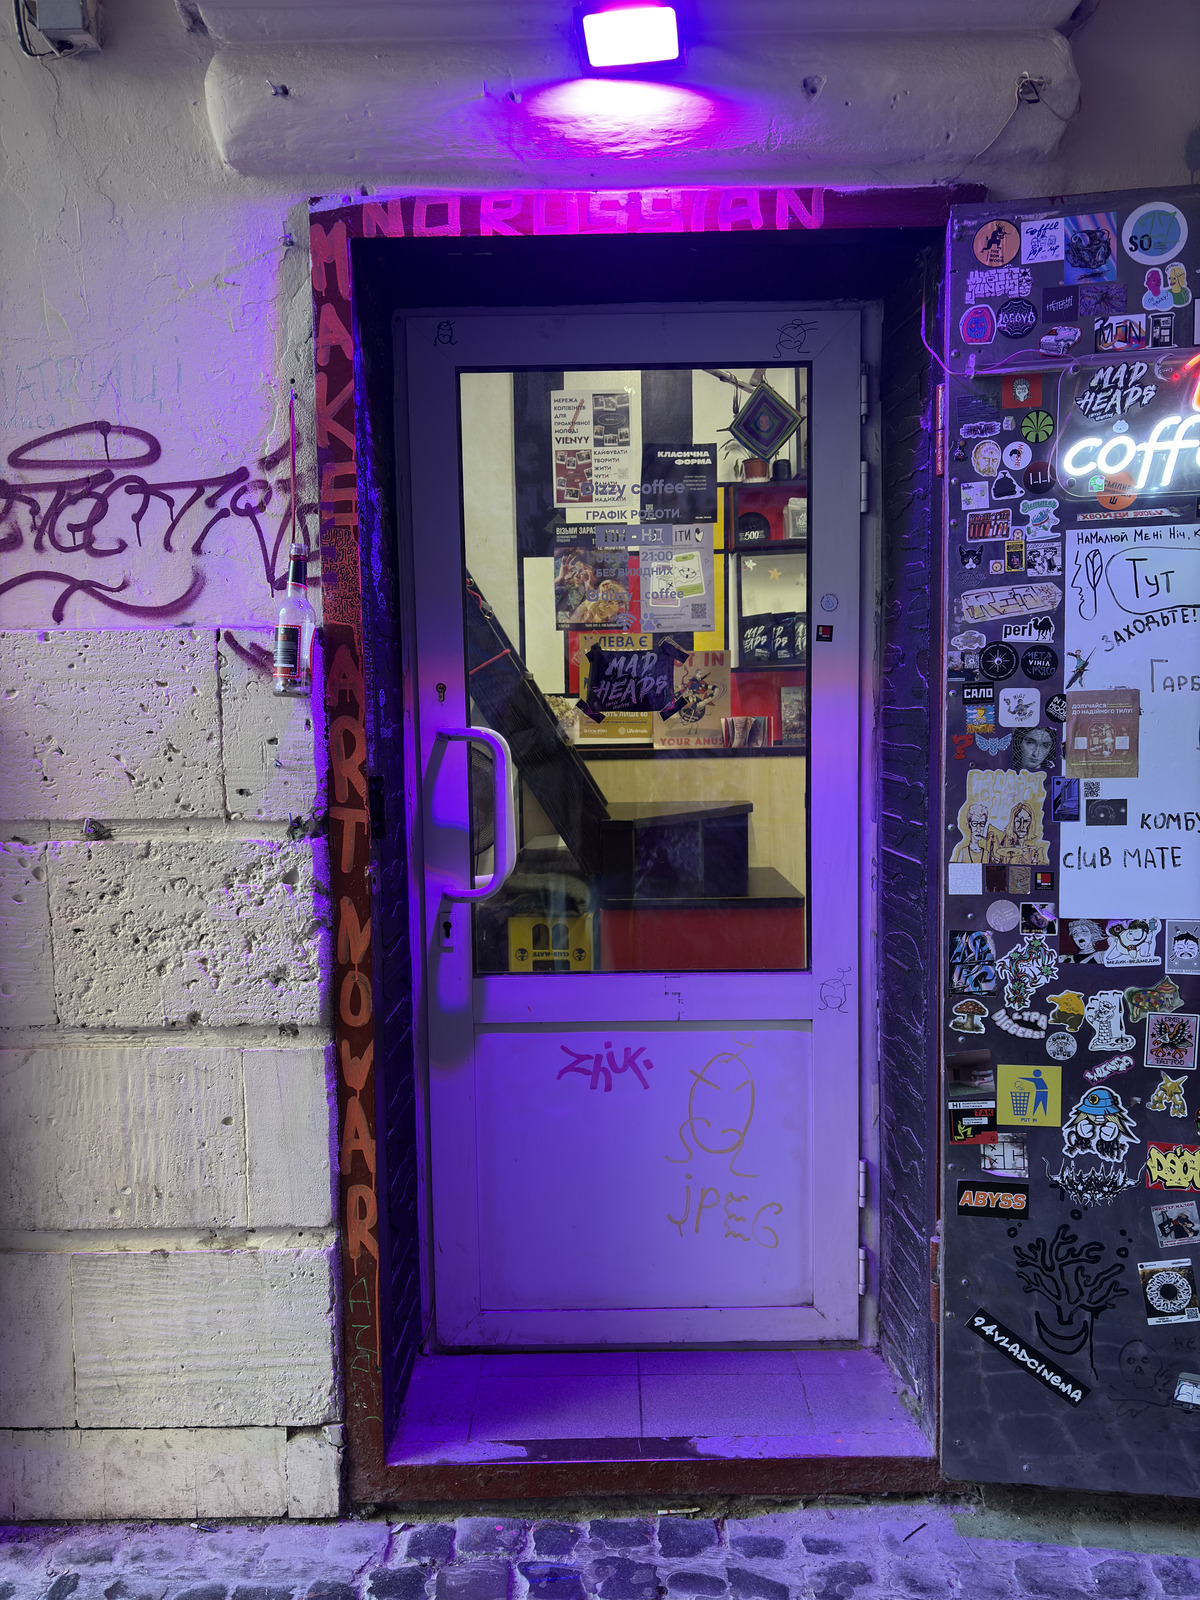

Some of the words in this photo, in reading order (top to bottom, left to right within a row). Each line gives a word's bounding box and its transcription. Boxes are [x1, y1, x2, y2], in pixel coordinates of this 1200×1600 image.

[362, 192, 461, 237] NO
[479, 186, 825, 236] RUSSIAN
[1089, 361, 1148, 389] MAD
[1076, 385, 1157, 415] HEADS
[553, 412, 567, 420] ДЛЯ
[657, 450, 710, 458] КЛАСИЧНА
[1063, 412, 1200, 489] coff
[674, 458, 713, 466] ФОРМА
[581, 480, 626, 499] Dizzy
[631, 479, 685, 495] coffee
[585, 510, 628, 520] ГРАФІК
[556, 527, 578, 535] ВІЗЬМИ
[744, 530, 760, 540] 500
[641, 551, 673, 562] 21:00
[595, 568, 617, 577] БЕЗ
[617, 567, 673, 577] ВИХІДНИХ
[1003, 623, 1033, 639] perl
[1101, 607, 1197, 652] ЗАХОДЬТЕ!
[638, 636, 648, 648] Є
[743, 635, 768, 650] EADS
[604, 651, 658, 678] MAD
[704, 652, 724, 667] IN
[593, 674, 668, 705] HEADS
[963, 688, 993, 699] САЛО
[660, 738, 690, 746] YOUR
[695, 737, 724, 746] ANUS
[1123, 846, 1182, 870] MATE
[991, 1008, 1046, 1039] DIGGERS!
[959, 1190, 1027, 1210] ABYSS
